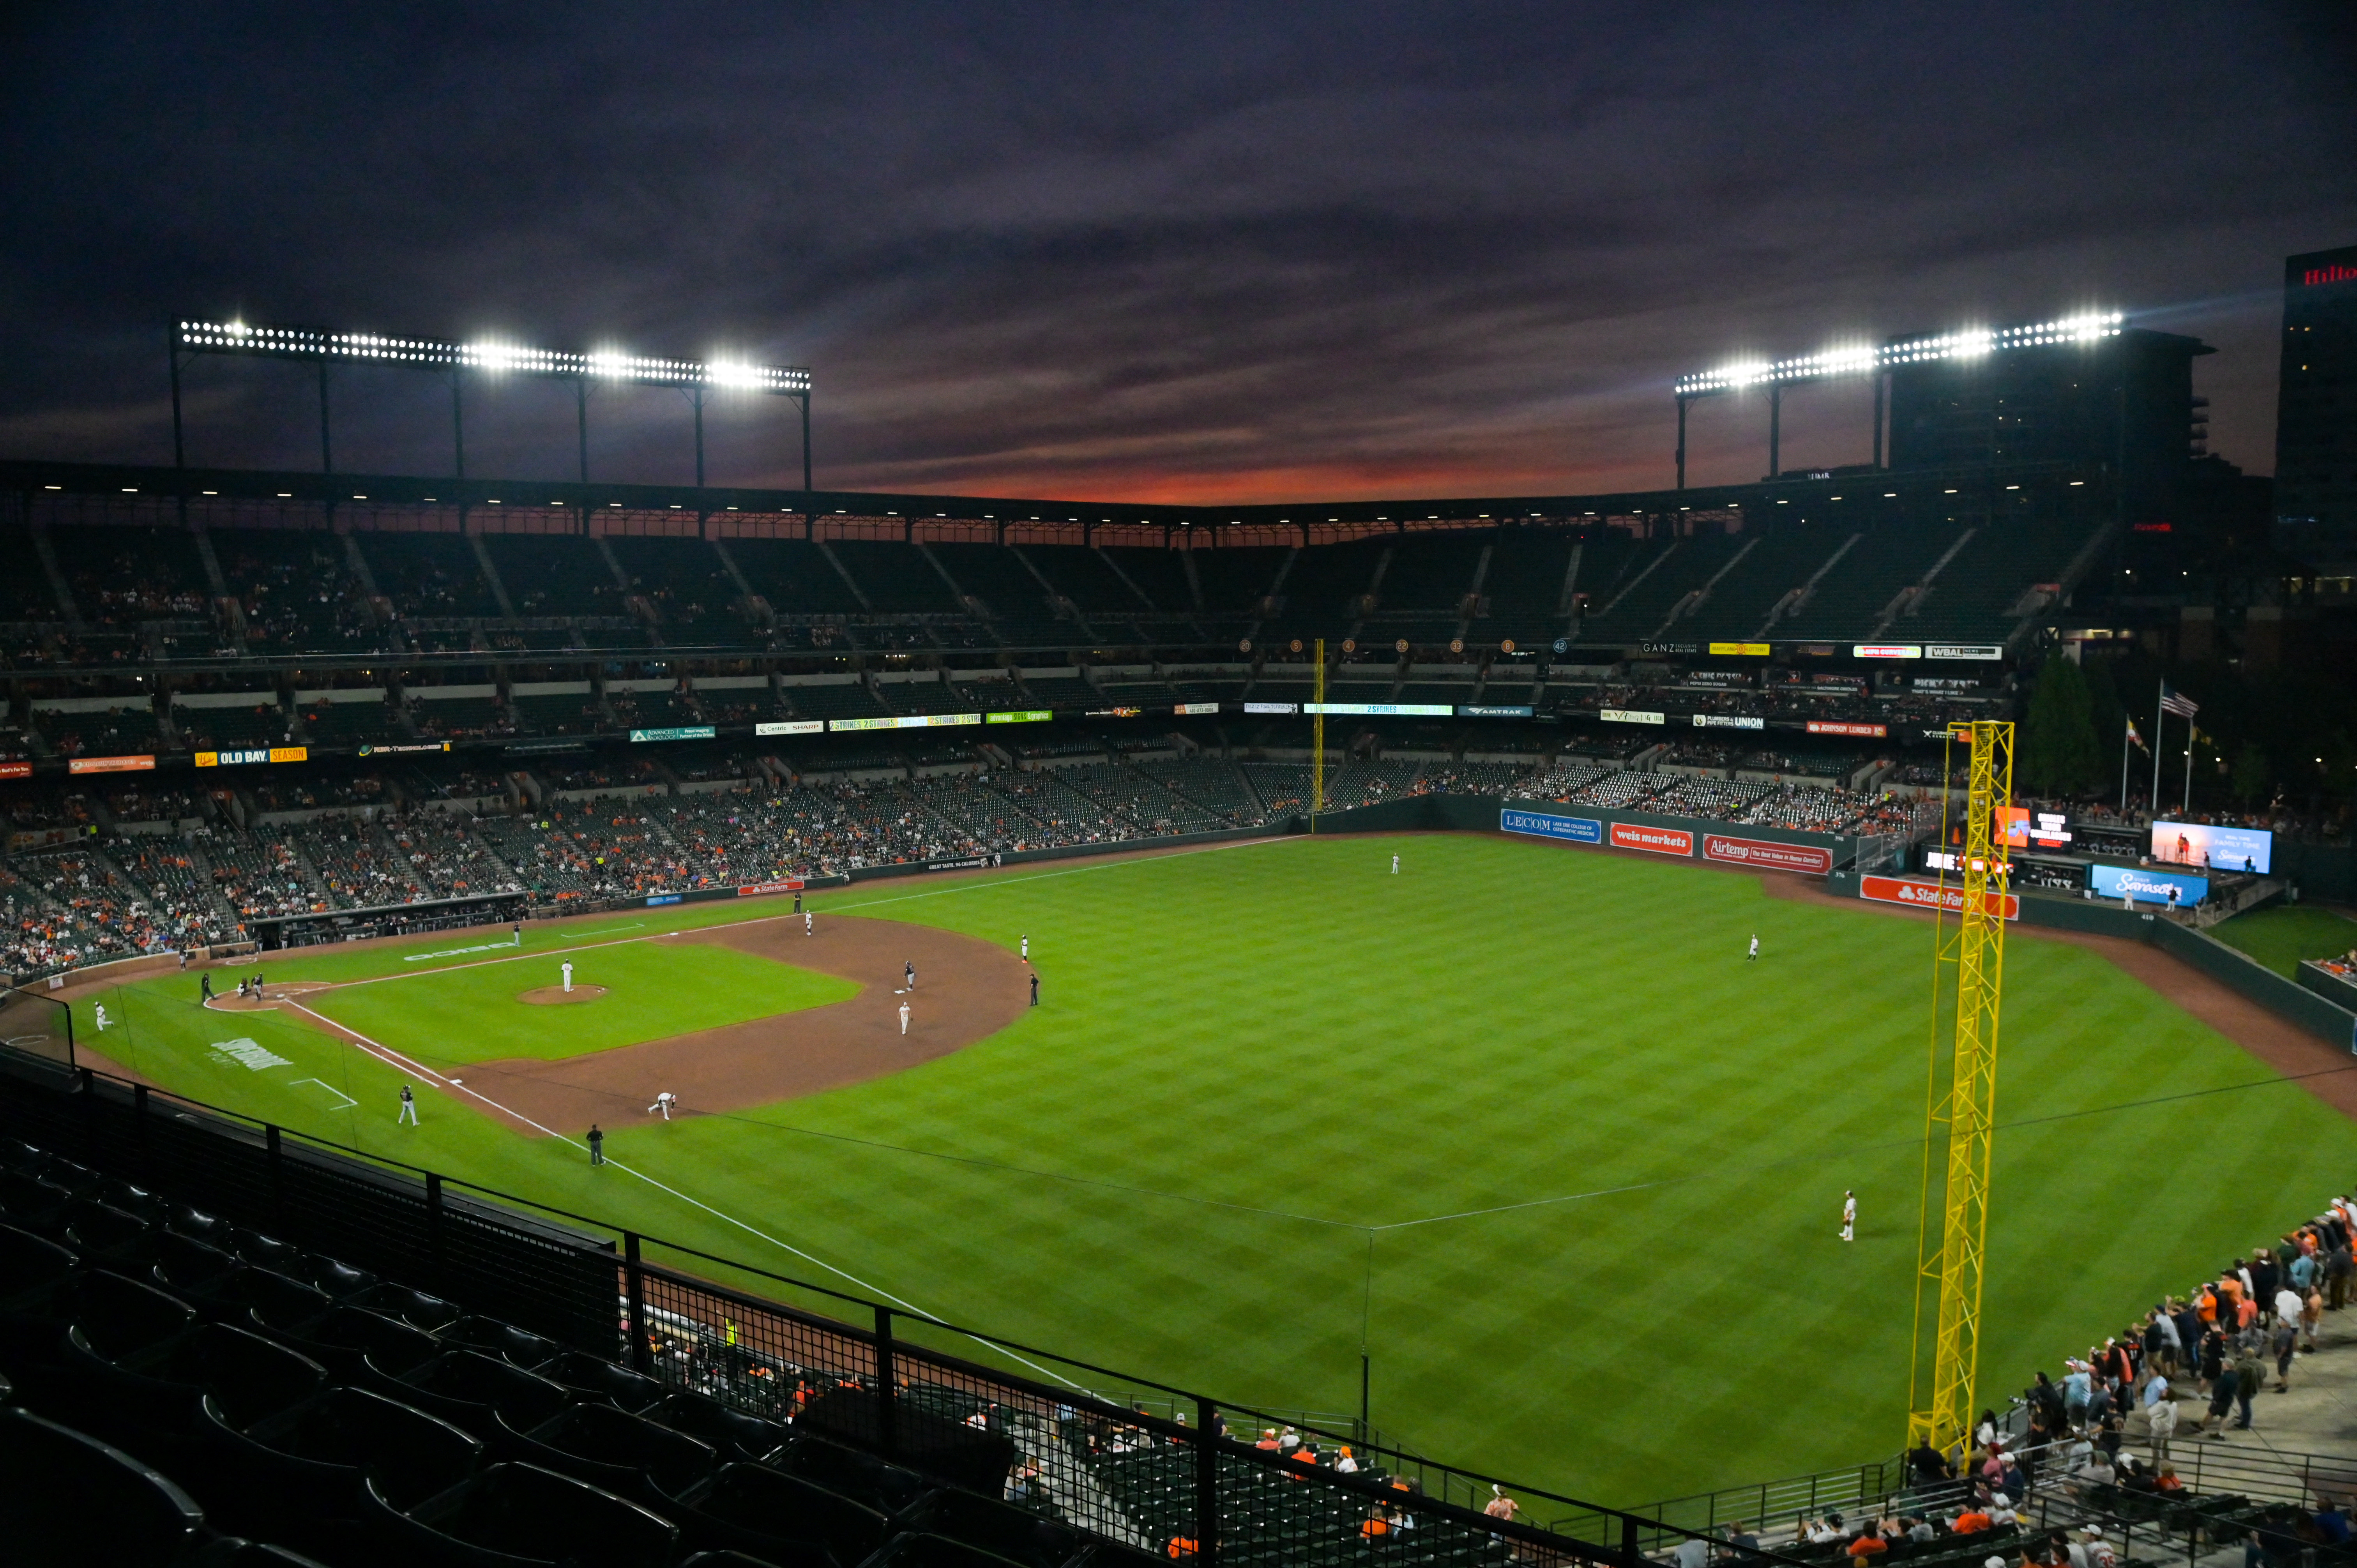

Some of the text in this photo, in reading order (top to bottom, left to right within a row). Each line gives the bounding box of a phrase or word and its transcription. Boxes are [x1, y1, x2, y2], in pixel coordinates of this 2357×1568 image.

[1643, 643, 1675, 652] GANZ
[990, 713, 1012, 722] advantage
[1031, 712, 1049, 721] graphics
[1735, 717, 1763, 727] UNION
[830, 720, 834, 730] 2
[835, 720, 861, 729] STRIKES
[864, 720, 868, 728] 2
[869, 719, 895, 728] STRIKES
[935, 716, 959, 725] STRIKES
[221, 752, 242, 764] OLD
[273, 749, 303, 760] SEASON
[1617, 831, 1686, 847] weis markets
[2214, 839, 2260, 850] FAMILY TIME
[1710, 840, 1749, 858] Airtemp
[1926, 851, 1955, 870] JUNE
